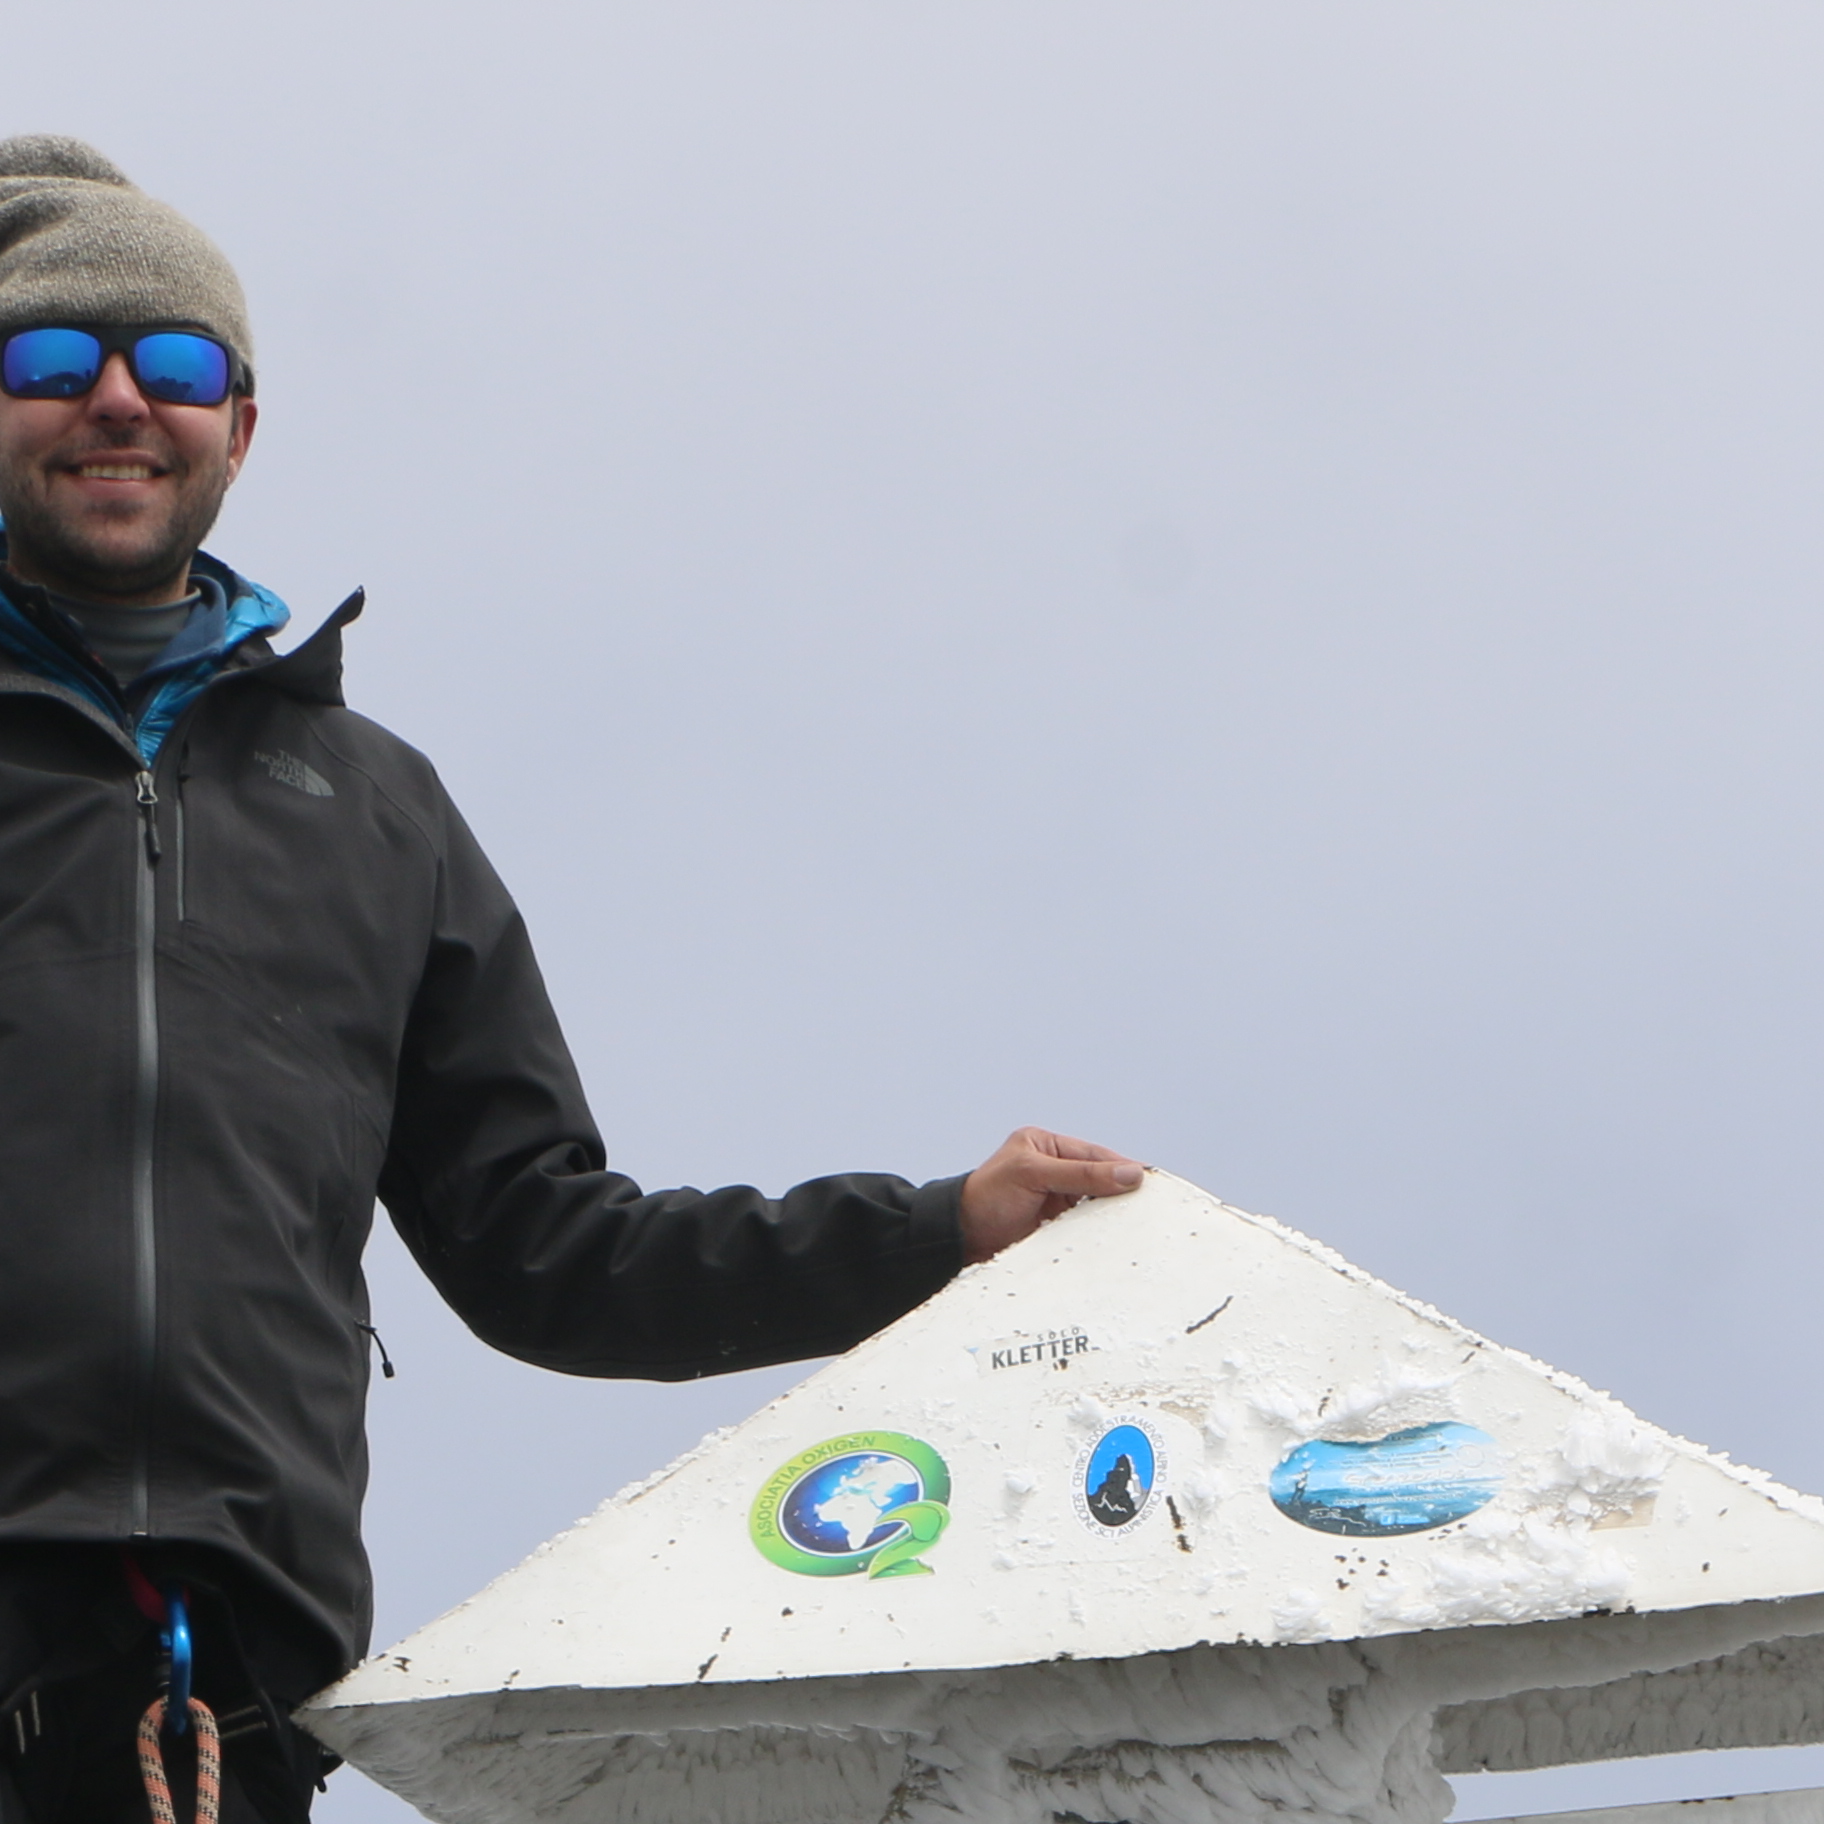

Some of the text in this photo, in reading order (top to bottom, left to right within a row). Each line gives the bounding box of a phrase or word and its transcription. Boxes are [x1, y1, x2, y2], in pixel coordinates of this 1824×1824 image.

[254, 750, 304, 781] NORTH
[279, 750, 304, 766] THE
[269, 766, 305, 792] FACE
[991, 1335, 1090, 1370] KLETTER
[1072, 1450, 1091, 1488] CENTRO
[758, 1435, 877, 1538] ASOCIATIA OXIGEN
